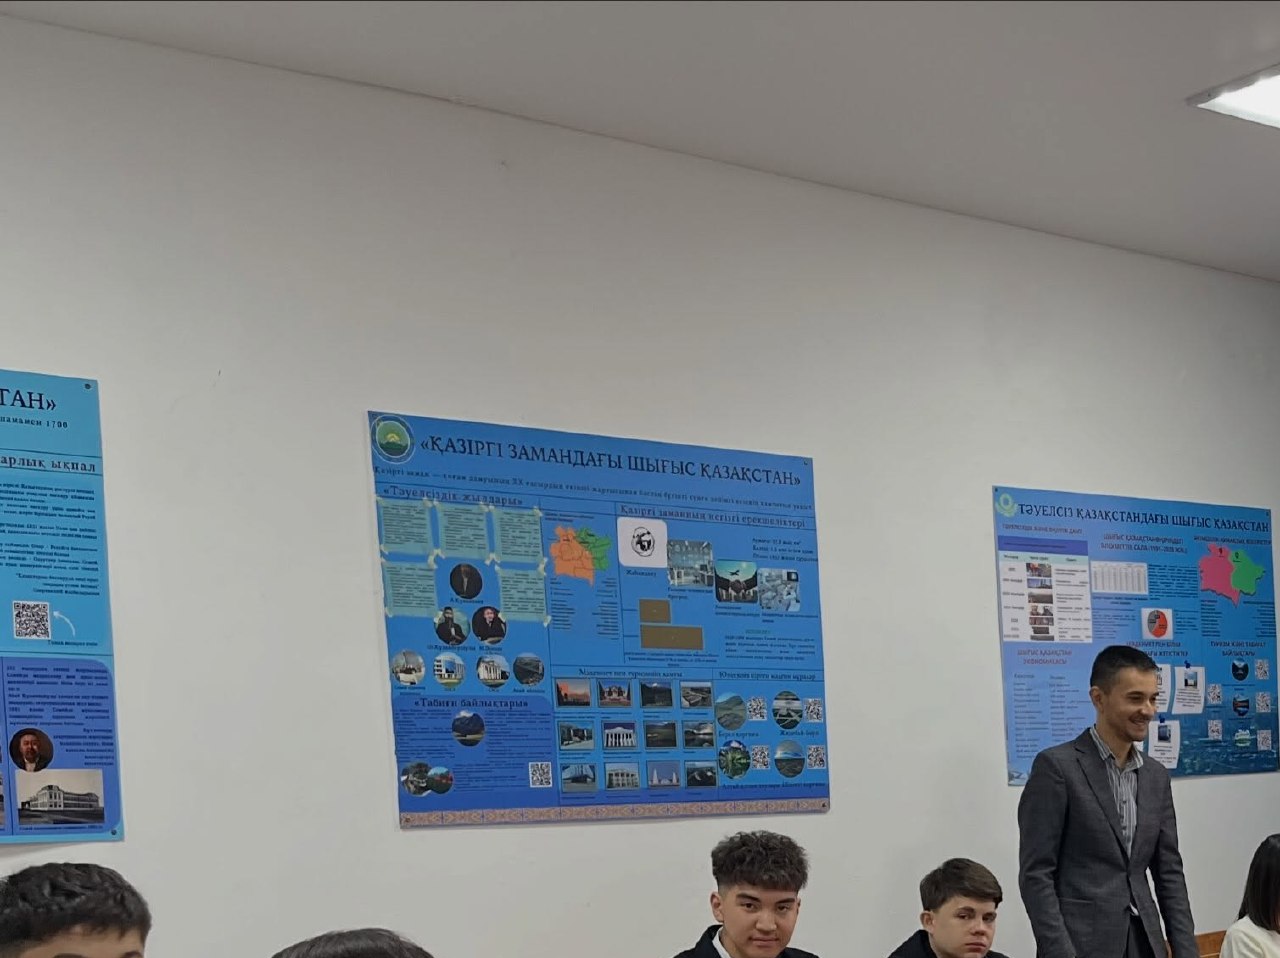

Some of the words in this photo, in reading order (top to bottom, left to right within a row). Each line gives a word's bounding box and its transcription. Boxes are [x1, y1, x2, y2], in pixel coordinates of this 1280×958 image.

[51, 460, 96, 473] ықпал
[421, 435, 503, 458] «ҚАЗІРГІ
[508, 443, 622, 469] ЗАМАНДАҒЫ
[628, 455, 696, 476] ШЫҒЫС
[700, 463, 801, 486] ҚАЗАҚСТАН»
[383, 485, 457, 501] «Тәуелсіздік
[462, 493, 523, 506] жылдары»
[620, 504, 656, 517] Қазіргі
[659, 510, 706, 520] заманның
[708, 514, 740, 523] негізгі
[741, 516, 805, 528] ерекшеліктері
[1017, 503, 1073, 517] ТӘУЕЛСІЗ
[1076, 508, 1169, 526] ҚАЗАҚСТАНДАҒЫ
[1213, 518, 1269, 533] ҚАЗАҚСТАН
[414, 697, 458, 708] «Табиғи
[460, 698, 529, 710] байлықтары»
